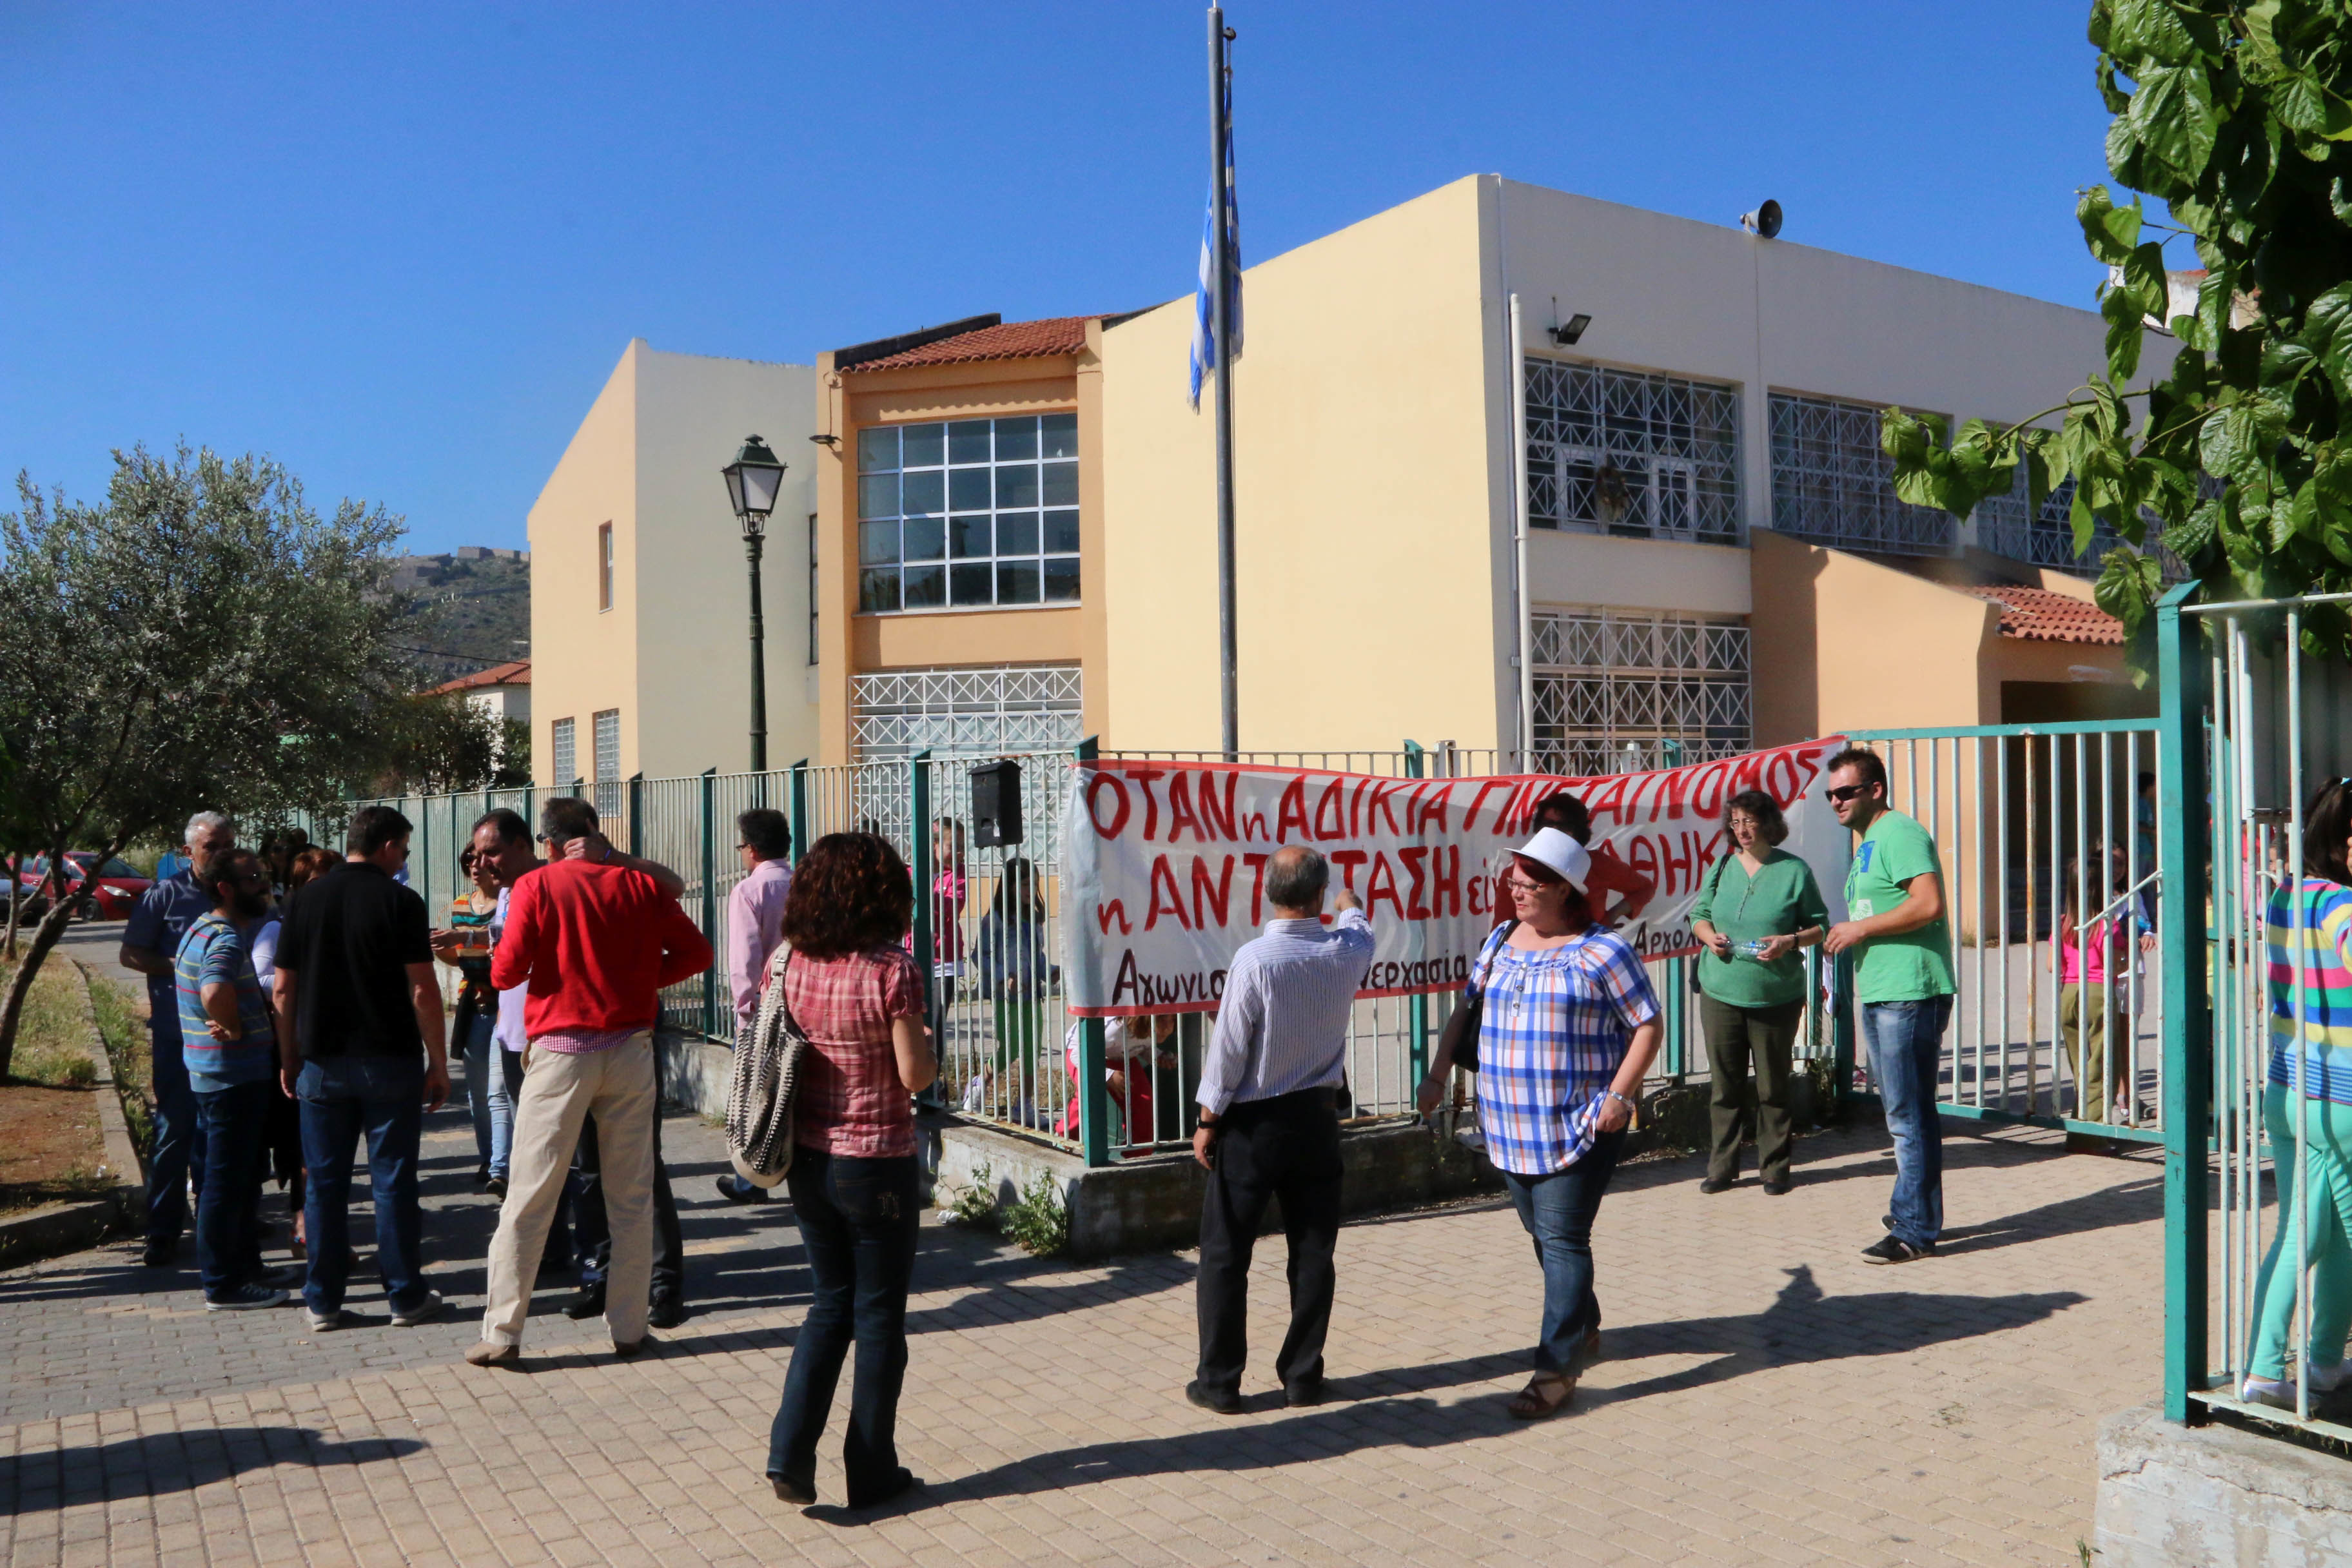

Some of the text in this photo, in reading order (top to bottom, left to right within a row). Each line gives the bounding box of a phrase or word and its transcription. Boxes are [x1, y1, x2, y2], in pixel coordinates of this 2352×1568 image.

[1086, 769, 1240, 843] ΟΤΑΝ
[1242, 812, 1269, 843] η
[1276, 774, 1455, 845] ΑΔΙΚΙΑ
[1097, 898, 1133, 936] η
[1144, 844, 1461, 931] ΑΝΤΤΑΣΗ
